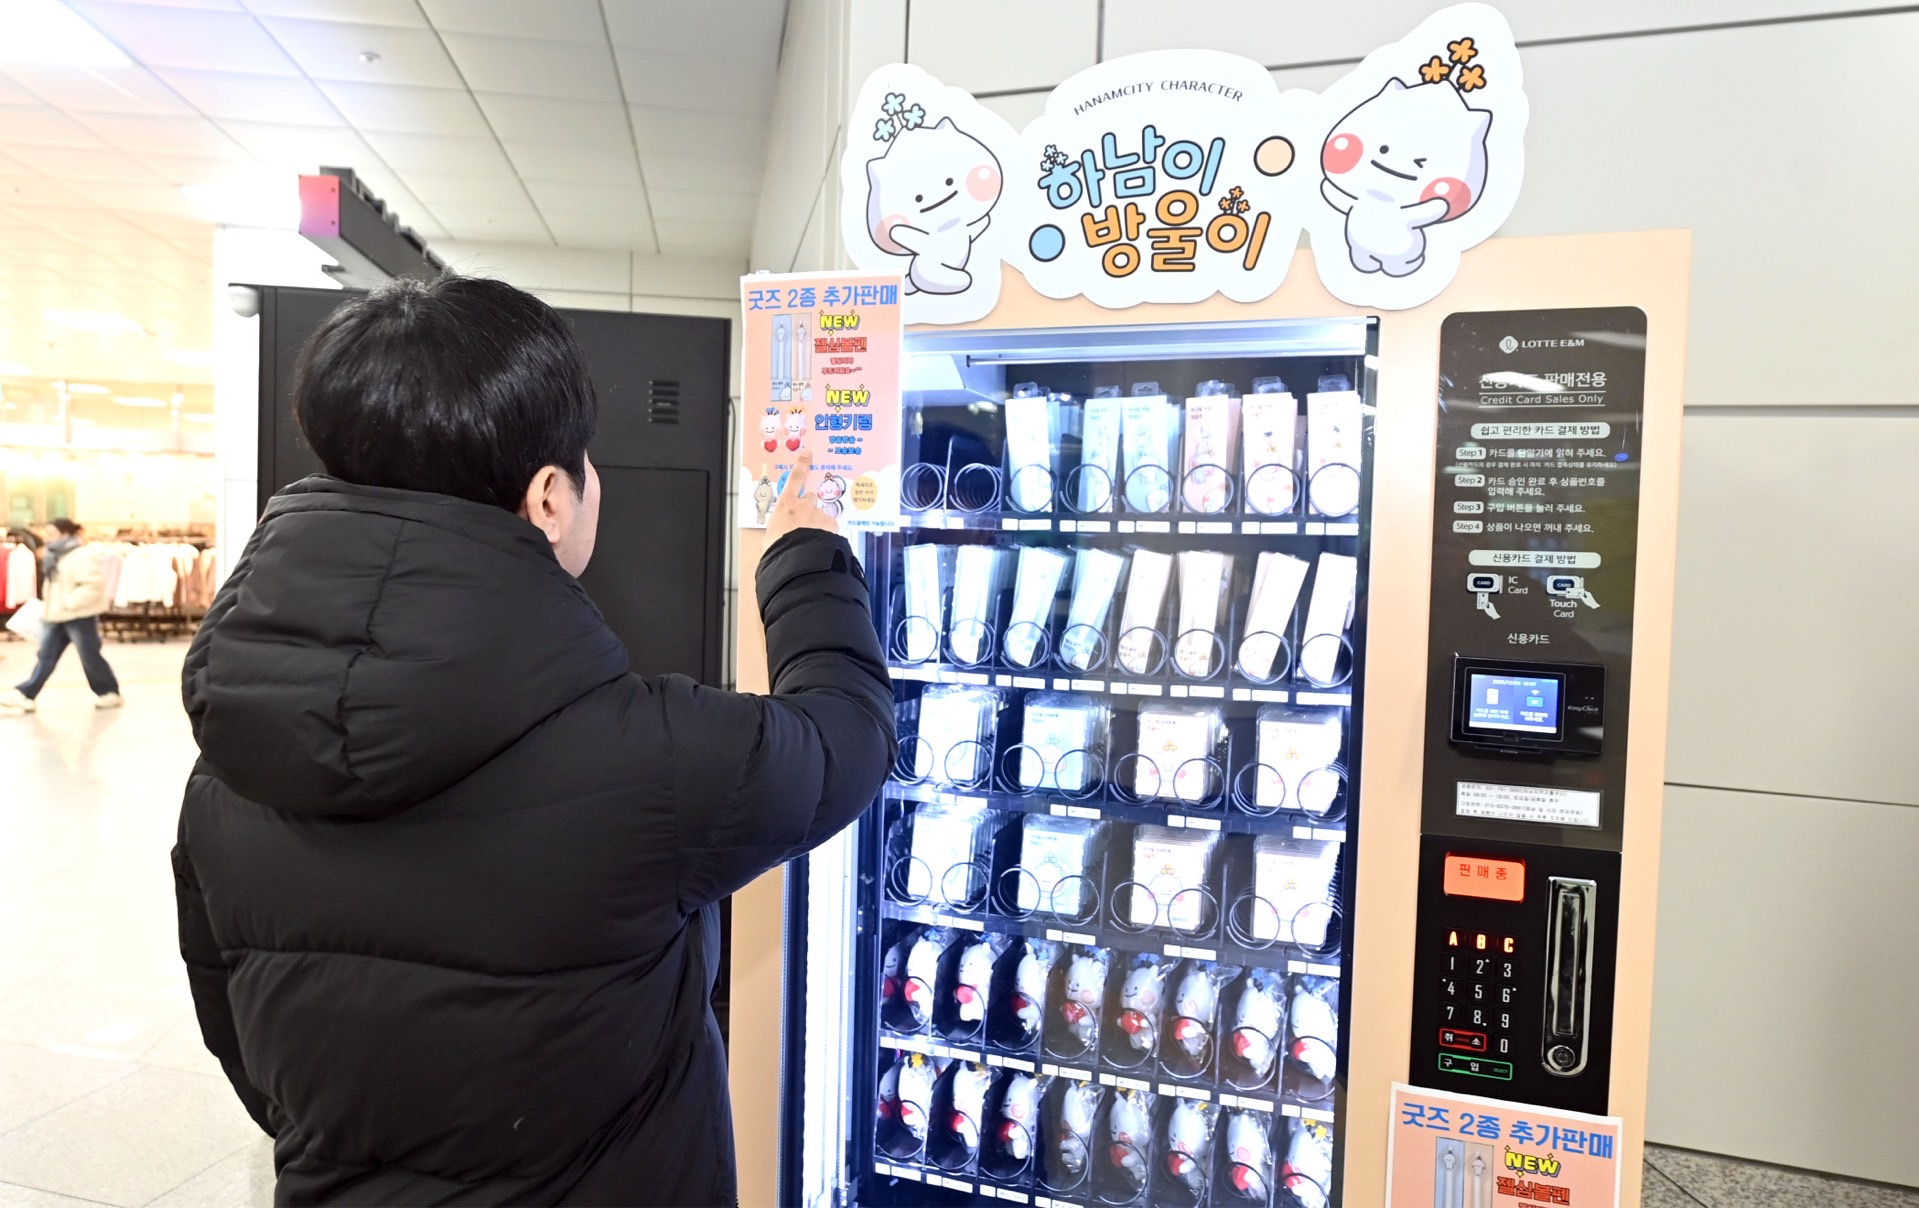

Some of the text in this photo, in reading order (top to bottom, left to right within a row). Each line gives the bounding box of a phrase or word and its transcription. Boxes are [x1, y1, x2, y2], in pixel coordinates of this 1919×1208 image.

[1073, 79, 1244, 116] HANAMCITY CHARACTER
[1038, 124, 1226, 210] 하남이
[1082, 189, 1271, 278] 방울이
[748, 284, 899, 311] 굿즈 2종 추가판매
[819, 314, 861, 331] NEW
[814, 336, 868, 353] 젤심볼펜
[1522, 338, 1585, 349] LOTTE E&M
[825, 389, 872, 407] NEW
[1480, 393, 1604, 405] Credit Card Sales Only
[814, 413, 873, 431] 인형키링
[1481, 424, 1601, 436] 쉽고 편리한 카드 결제 방법
[1459, 449, 1483, 458] Step 1
[1489, 448, 1607, 458] 카드를 단말기에 읽혀 주세요.
[1485, 461, 1497, 469] 경우
[1458, 476, 1482, 485] Step 2
[1487, 477, 1606, 487] 카드 승인 완료 후 상품번호를
[1487, 487, 1545, 496] 입력해 주세요.
[1457, 503, 1481, 512] Step 3
[1486, 503, 1585, 513] 구입 버튼을 눌러 주세요.
[1456, 522, 1480, 531] Step 4
[1486, 523, 1595, 533] 상품이 나오면 꺼내 주세요.
[1492, 553, 1576, 564] 신용카드 결제 방법
[1508, 576, 1519, 584] IC
[1508, 586, 1529, 595] Card
[1549, 599, 1577, 608] Touch
[1553, 610, 1575, 618] Card
[1507, 633, 1550, 645] 신용카드
[1449, 930, 1458, 947] A
[1476, 934, 1486, 950] B
[1503, 937, 1514, 953] C
[1450, 956, 1455, 971] 1
[1476, 959, 1484, 975] 2
[1503, 962, 1512, 978] 3
[1447, 981, 1455, 996] 4
[1474, 984, 1483, 999] 5
[1502, 988, 1511, 1003] 6
[1446, 1006, 1454, 1021] 7
[1473, 1009, 1482, 1025] 8
[1501, 1013, 1510, 1029] 9
[1500, 1038, 1508, 1053] 0
[1401, 1102, 1613, 1159] 굿즈 2종 추가판매
[1504, 1150, 1561, 1178] NEW
[1496, 1176, 1571, 1206] 젤심볼펜
